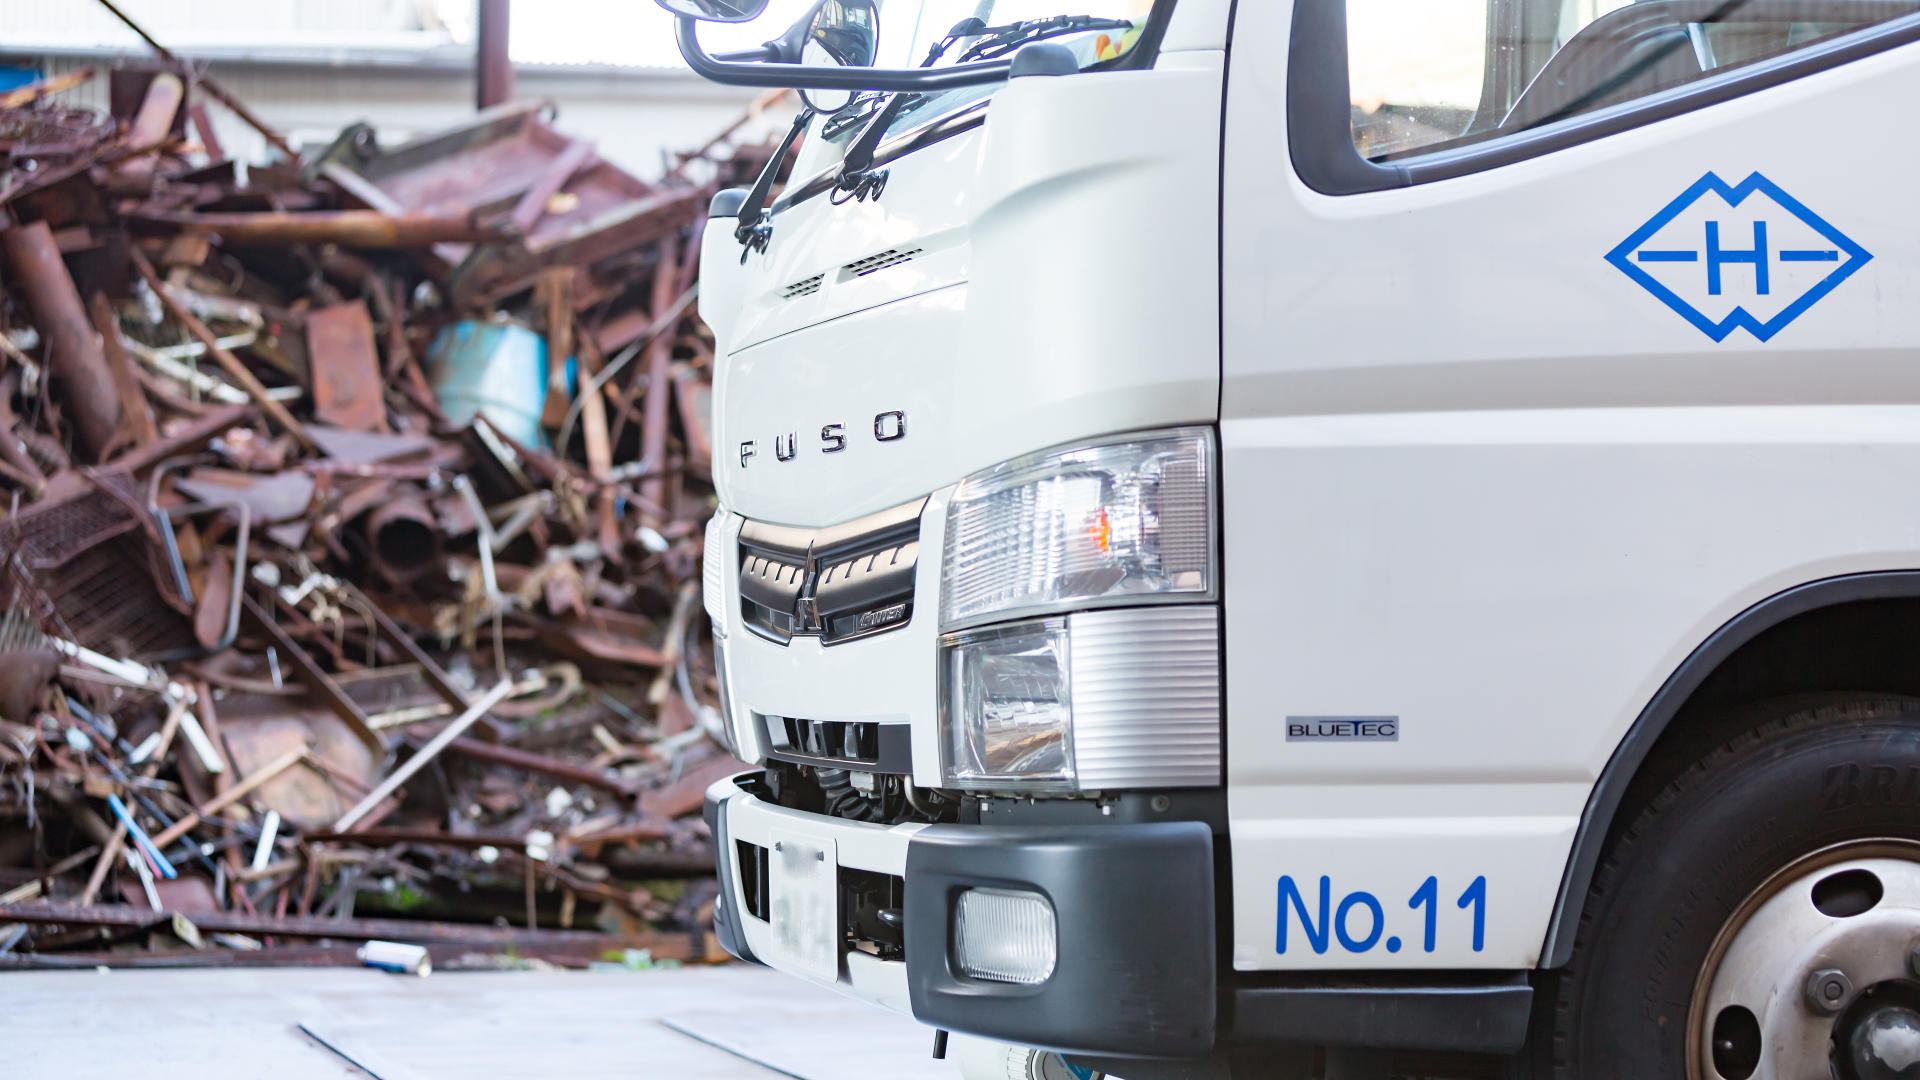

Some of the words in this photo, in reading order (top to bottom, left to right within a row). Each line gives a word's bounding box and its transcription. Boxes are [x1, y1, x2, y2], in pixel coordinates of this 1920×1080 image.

[1705, 220, 1770, 296] H
[740, 410, 907, 469] FUSO
[1288, 720, 1396, 737] BLUETEC
[1275, 874, 1487, 955] No.11
